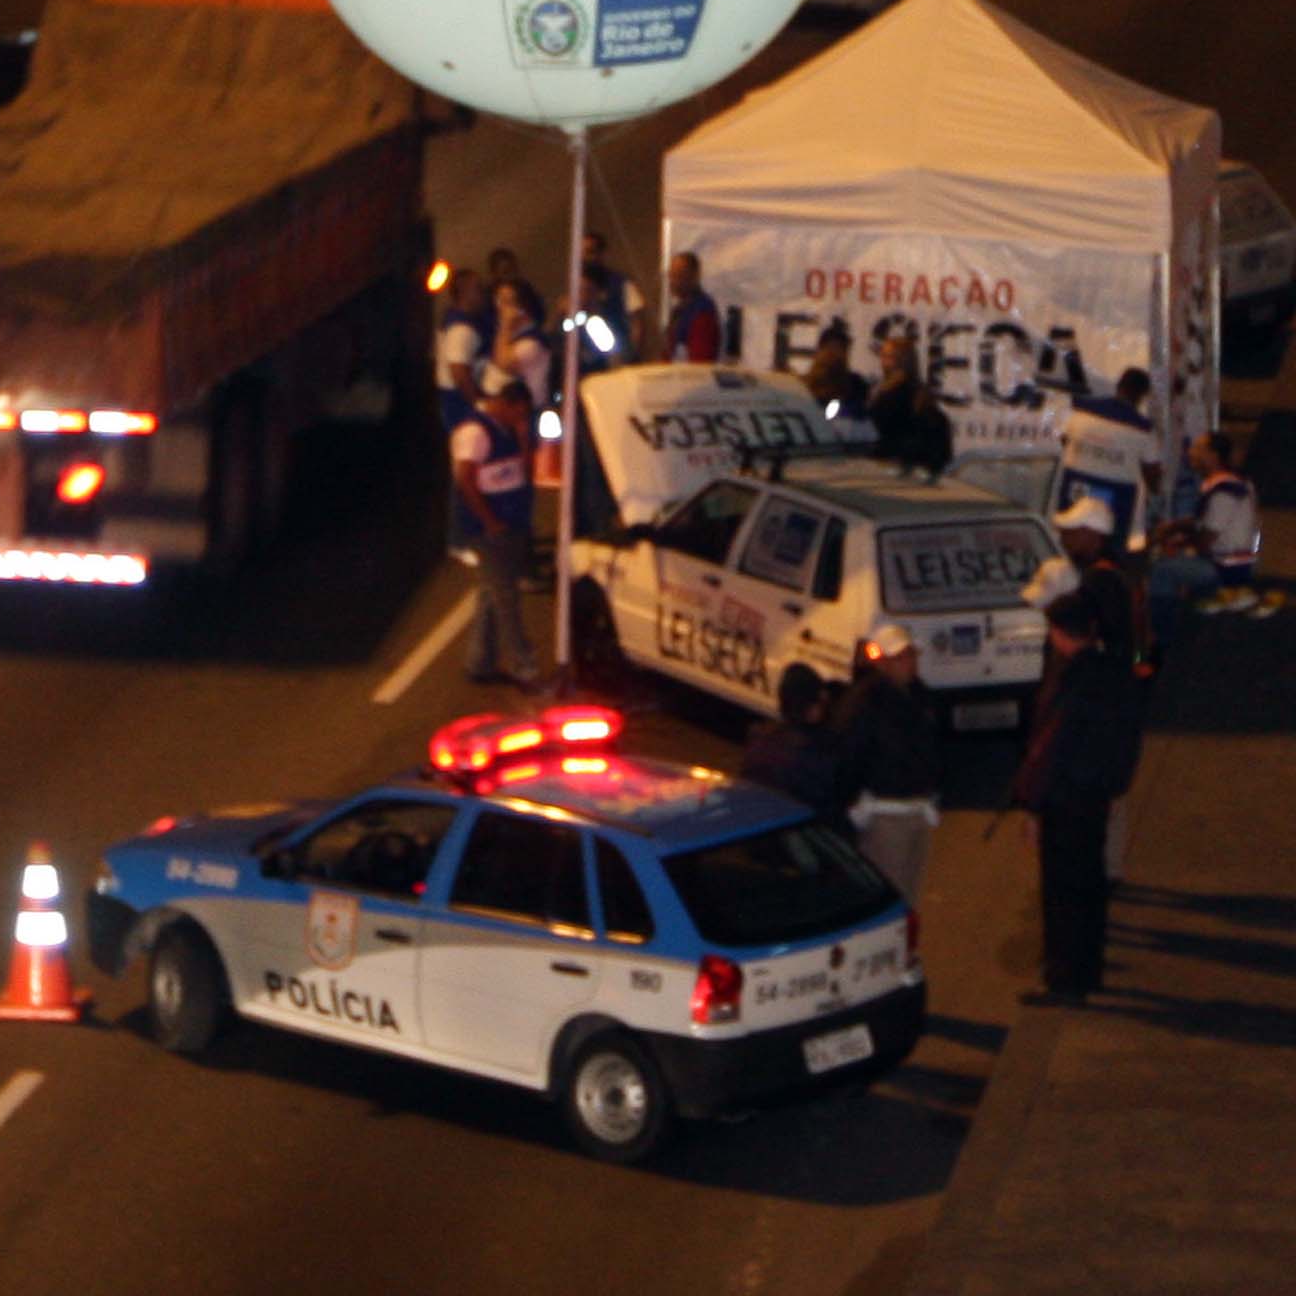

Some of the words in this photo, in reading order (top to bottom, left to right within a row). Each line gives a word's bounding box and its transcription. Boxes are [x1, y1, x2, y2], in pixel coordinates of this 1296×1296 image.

[599, 37, 686, 60] Janeiro
[602, 23, 641, 42] Rio
[644, 21, 675, 40] de
[805, 268, 1016, 312] OPERAÇÃO
[895, 552, 954, 592] LEI
[656, 602, 695, 664] LEI
[699, 616, 772, 697] SECA
[263, 971, 401, 1034] POLÍCIA
